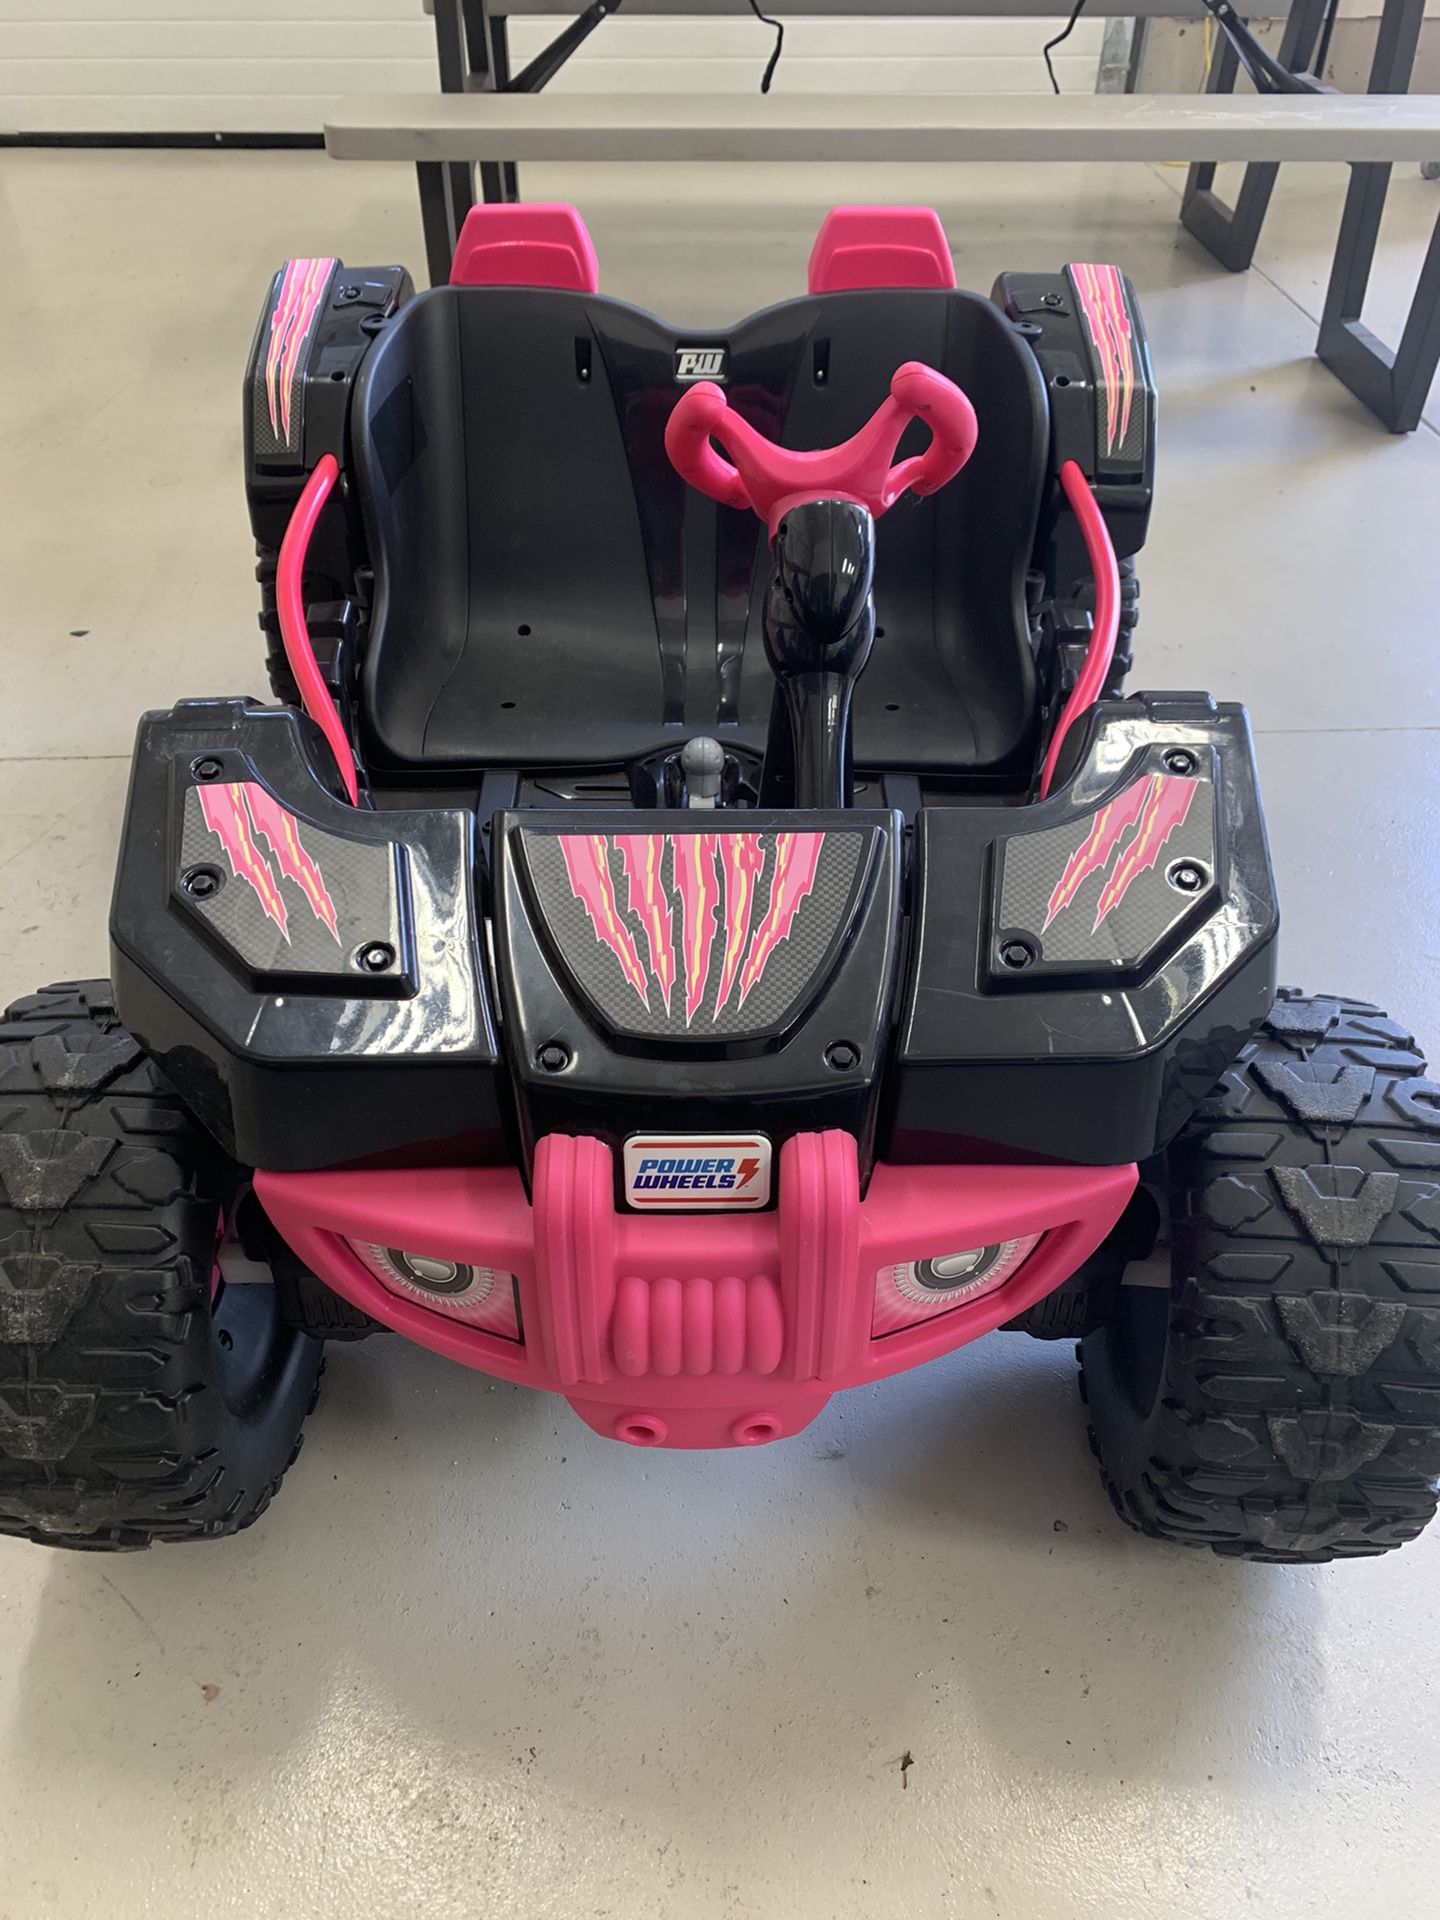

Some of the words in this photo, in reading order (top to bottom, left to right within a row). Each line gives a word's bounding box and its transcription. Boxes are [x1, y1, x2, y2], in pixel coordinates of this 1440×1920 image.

[677, 353, 723, 374] PW
[638, 1159, 735, 1174] POWER
[633, 1175, 736, 1189] WHEELS
